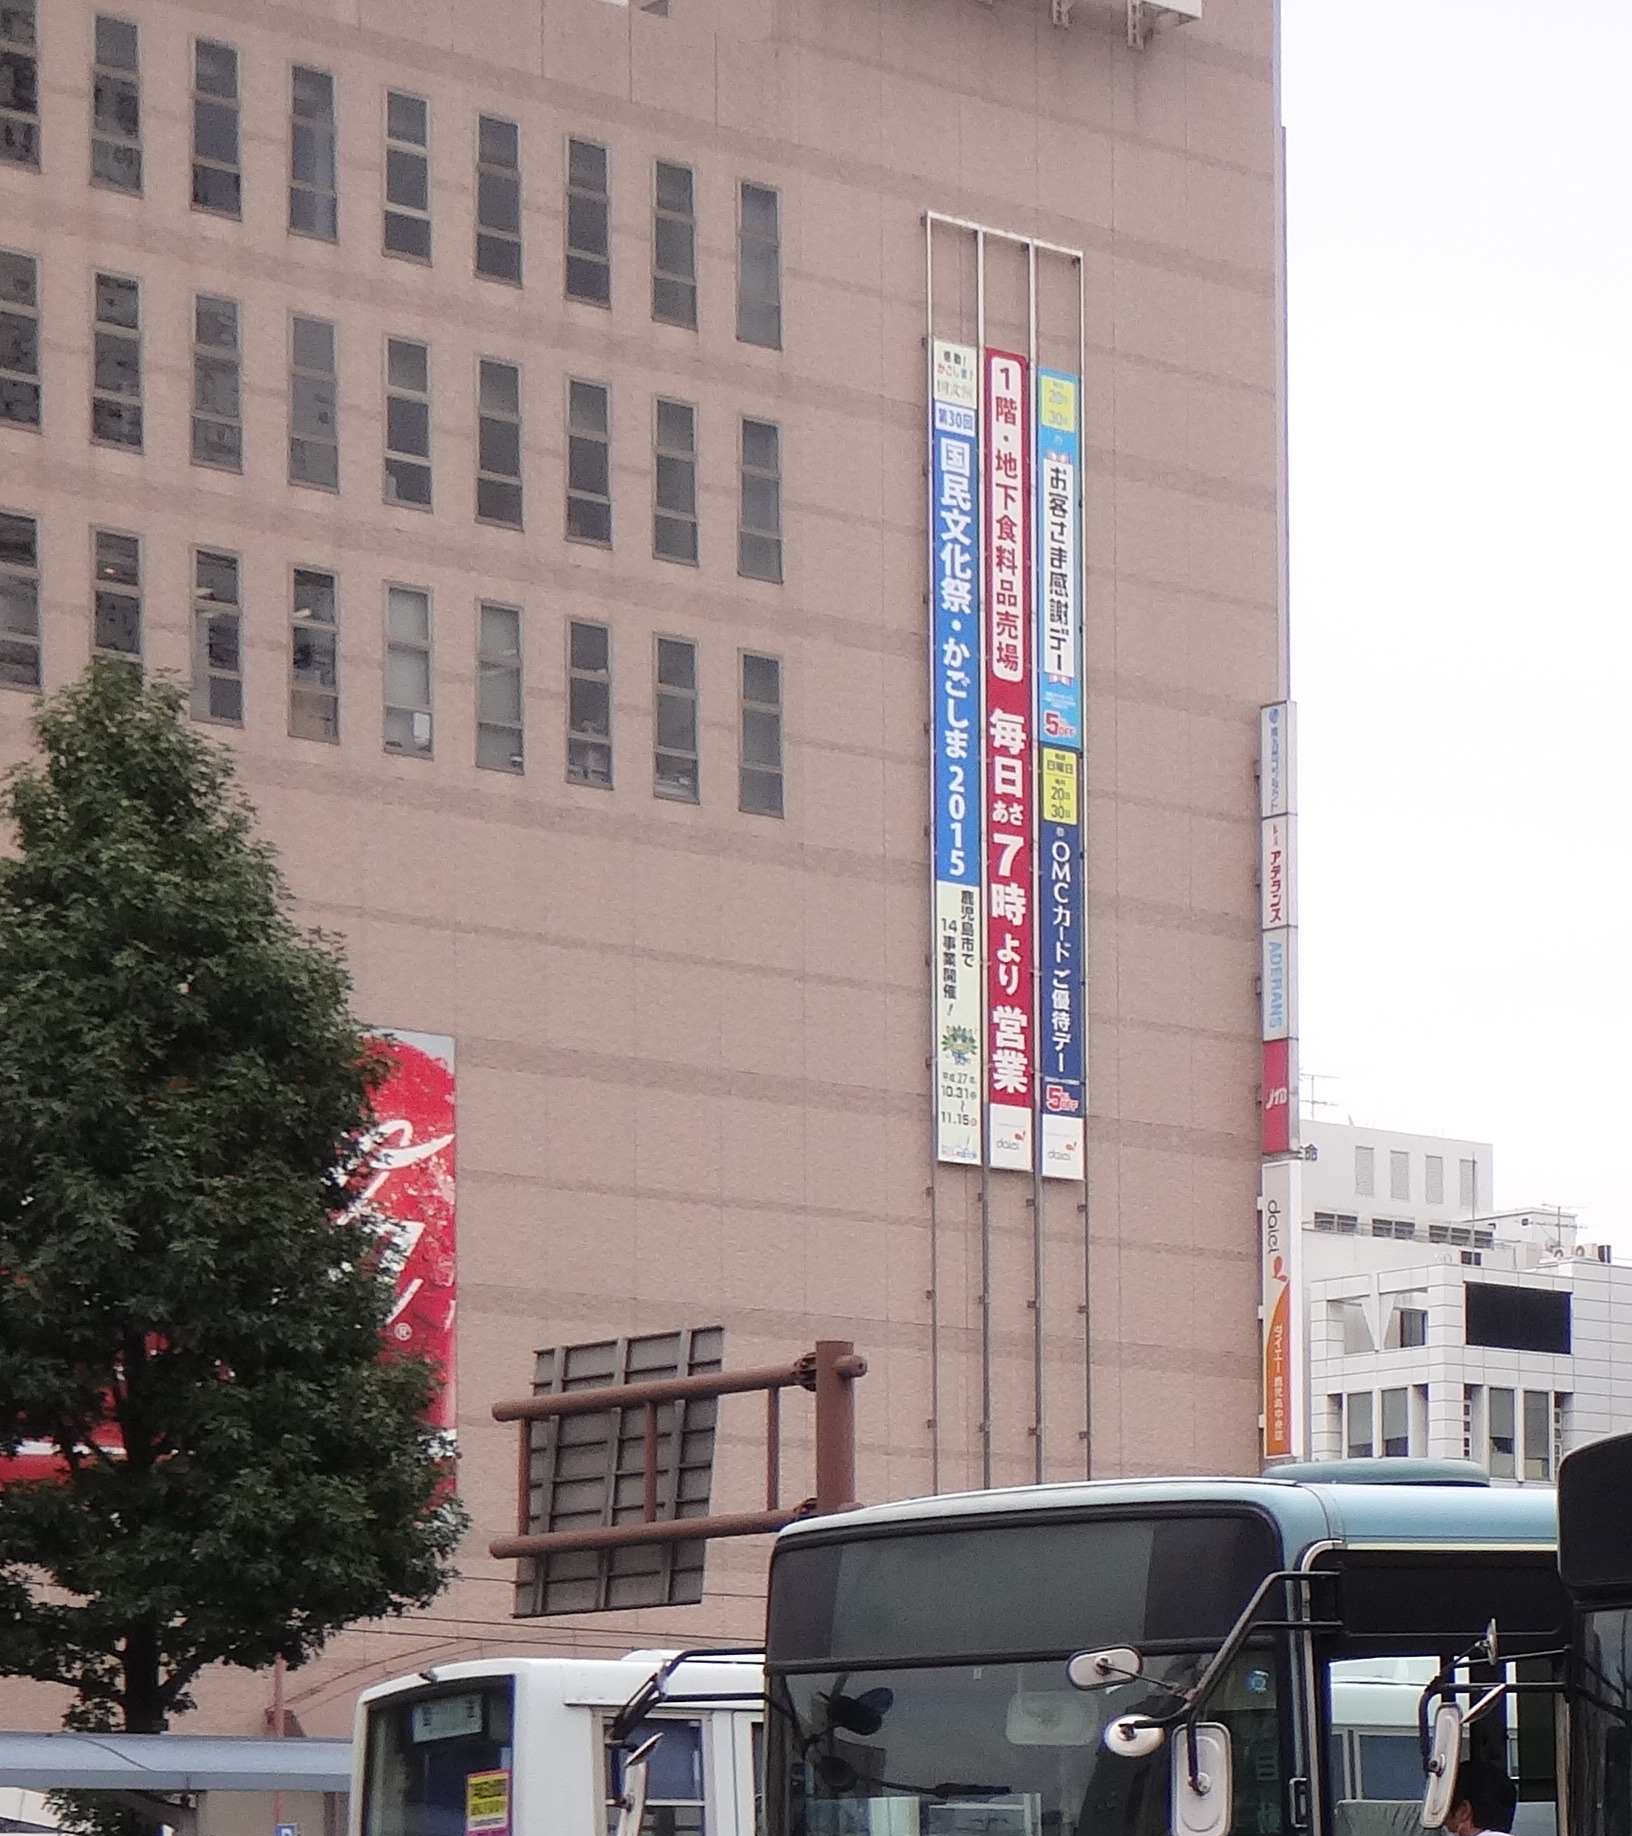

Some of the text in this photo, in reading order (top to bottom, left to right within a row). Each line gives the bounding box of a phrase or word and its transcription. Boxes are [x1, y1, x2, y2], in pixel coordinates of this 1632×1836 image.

[1049, 467, 1069, 672] お客さま感謝デー
[1047, 761, 1074, 775] 日曜日
[1270, 850, 1282, 924] アデランス
